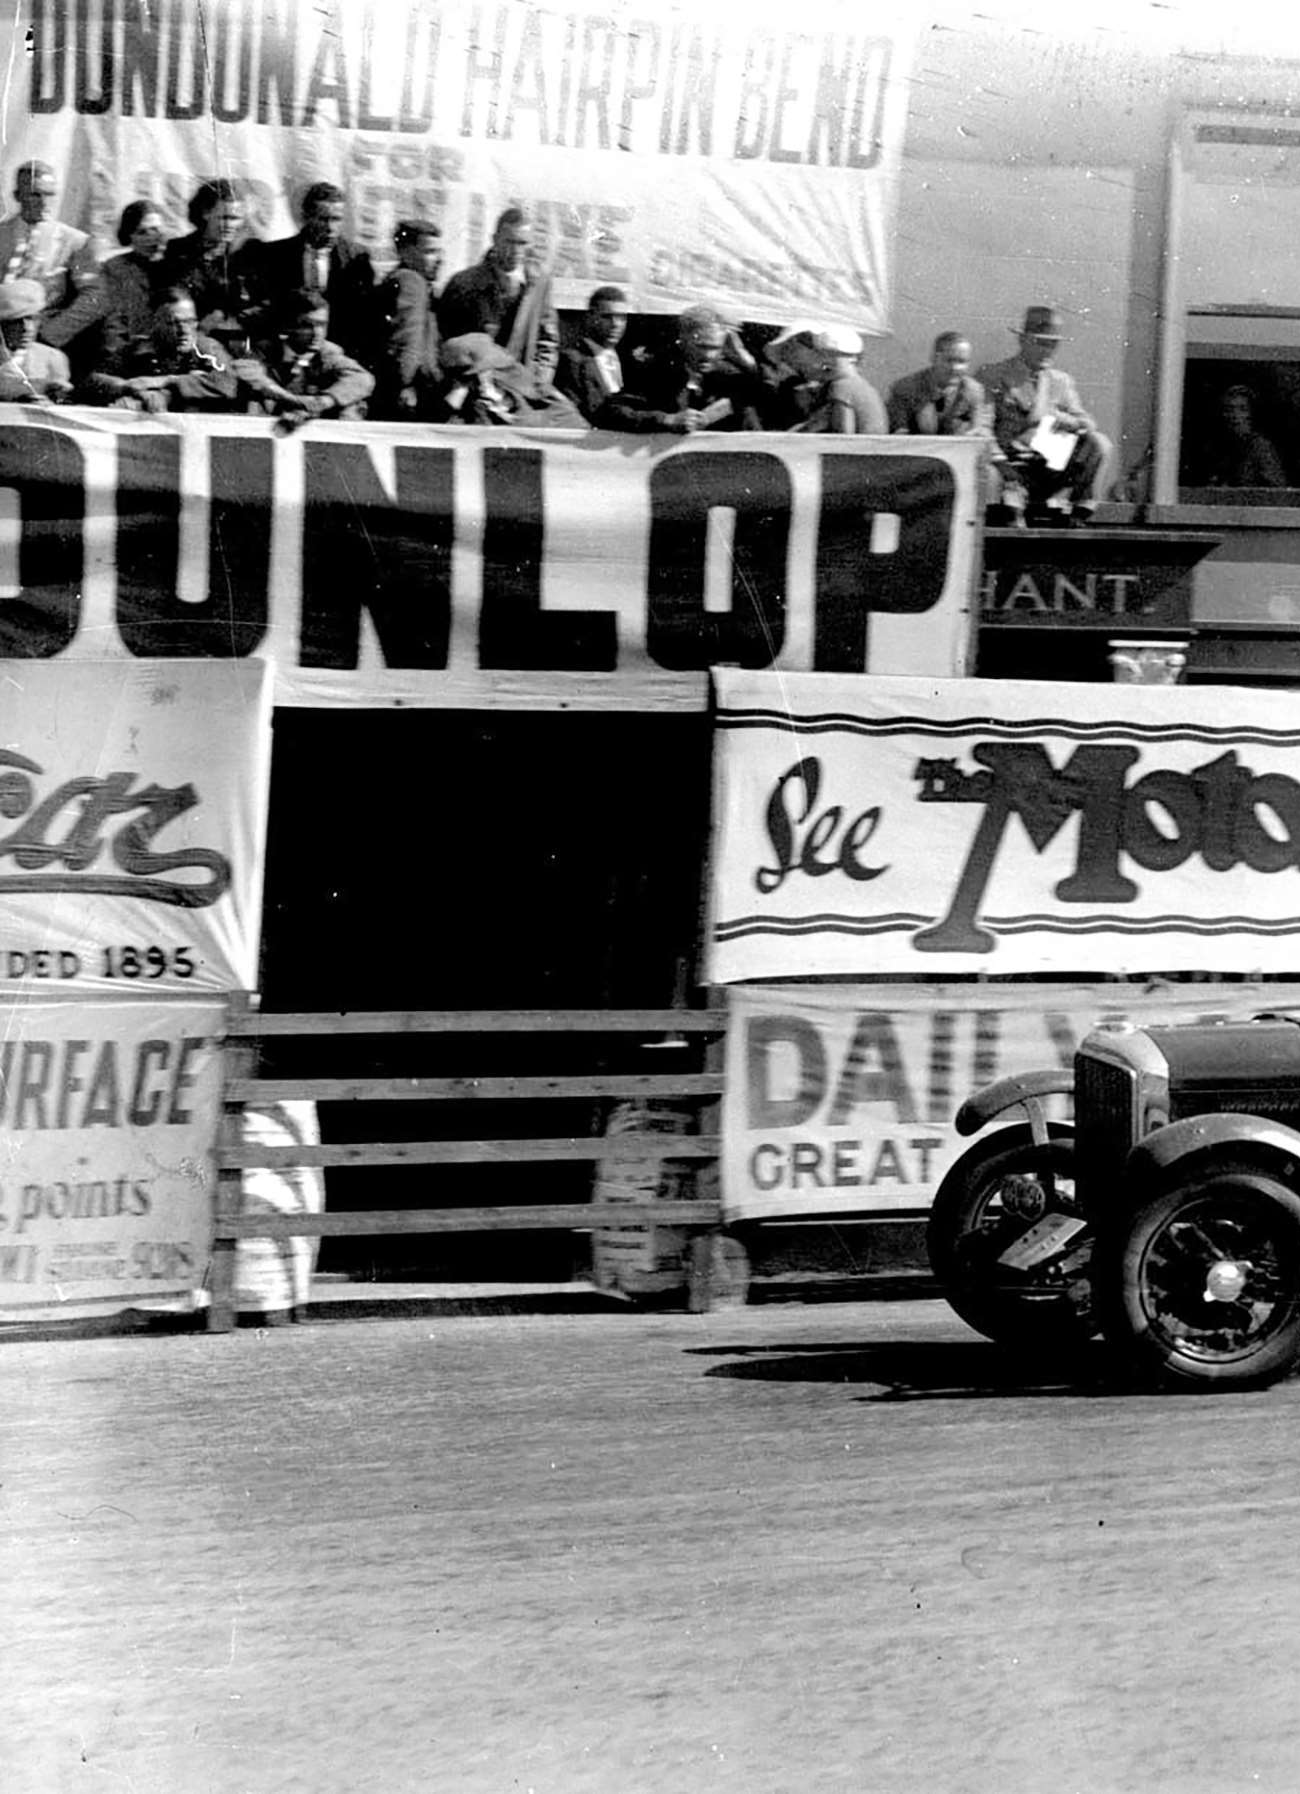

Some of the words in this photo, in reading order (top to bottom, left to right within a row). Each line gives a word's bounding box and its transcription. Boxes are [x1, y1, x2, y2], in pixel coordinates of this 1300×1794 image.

[29, 0, 442, 133] DUNDONALD
[459, 4, 724, 156] HAIRPIN
[734, 27, 896, 169] BEND
[755, 757, 891, 893] See
[101, 944, 198, 979] 1895
[750, 1137, 944, 1190] GREAT
